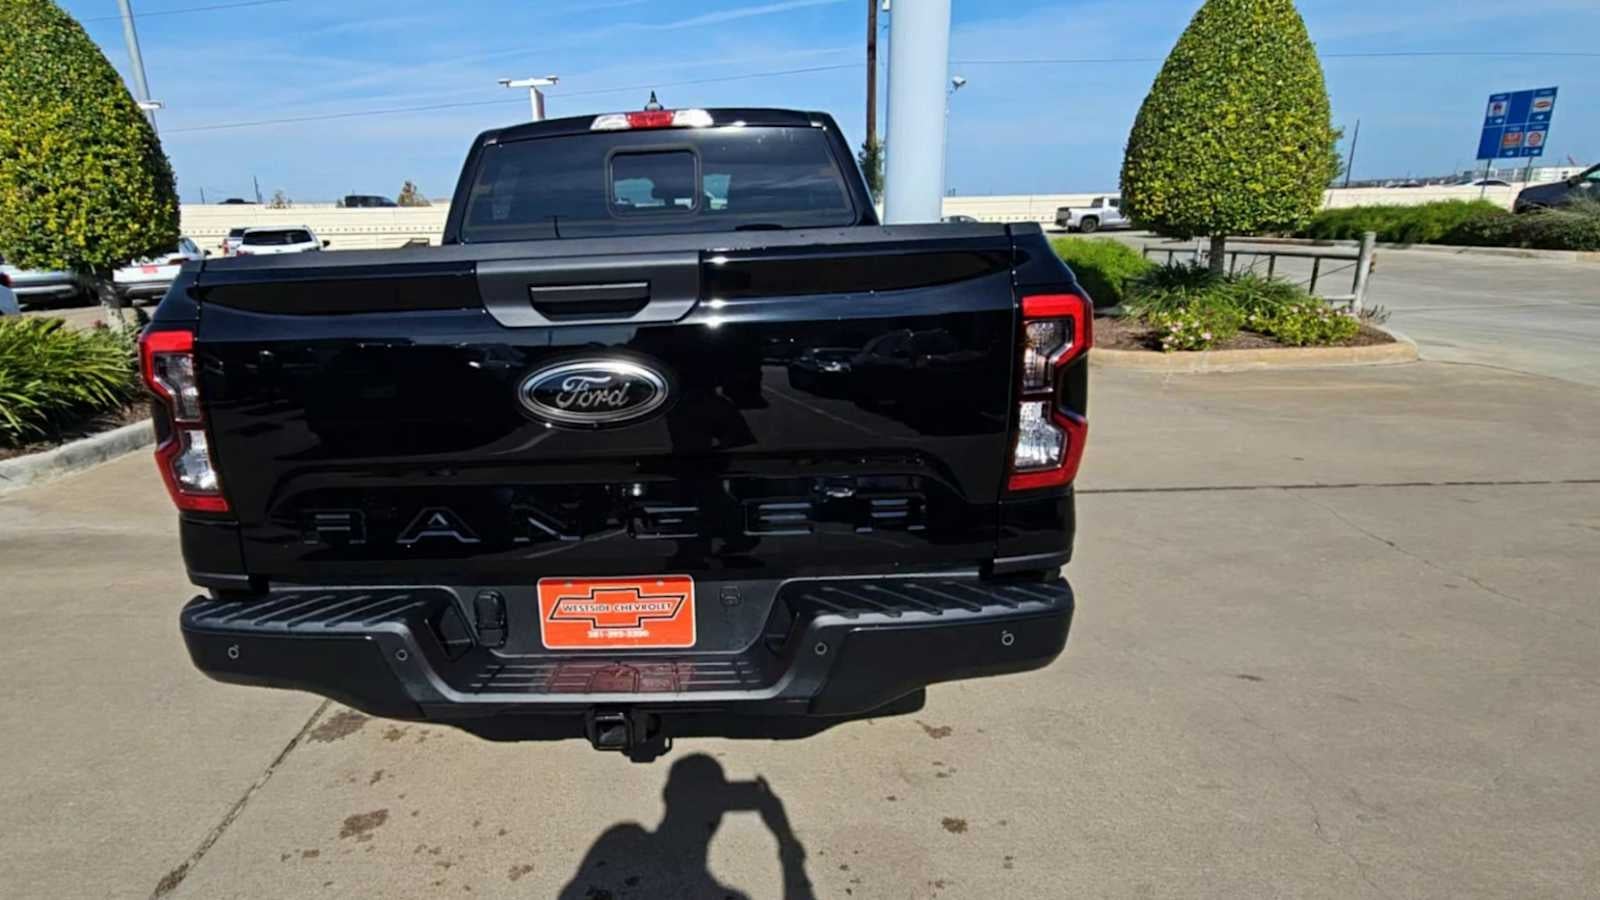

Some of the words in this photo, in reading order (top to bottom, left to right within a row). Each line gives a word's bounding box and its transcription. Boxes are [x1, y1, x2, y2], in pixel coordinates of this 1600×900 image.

[555, 375, 632, 408] Ford
[303, 492, 927, 545] RANGER
[562, 602, 610, 612] WESTSIDE
[613, 601, 672, 612] CHEVROLET
